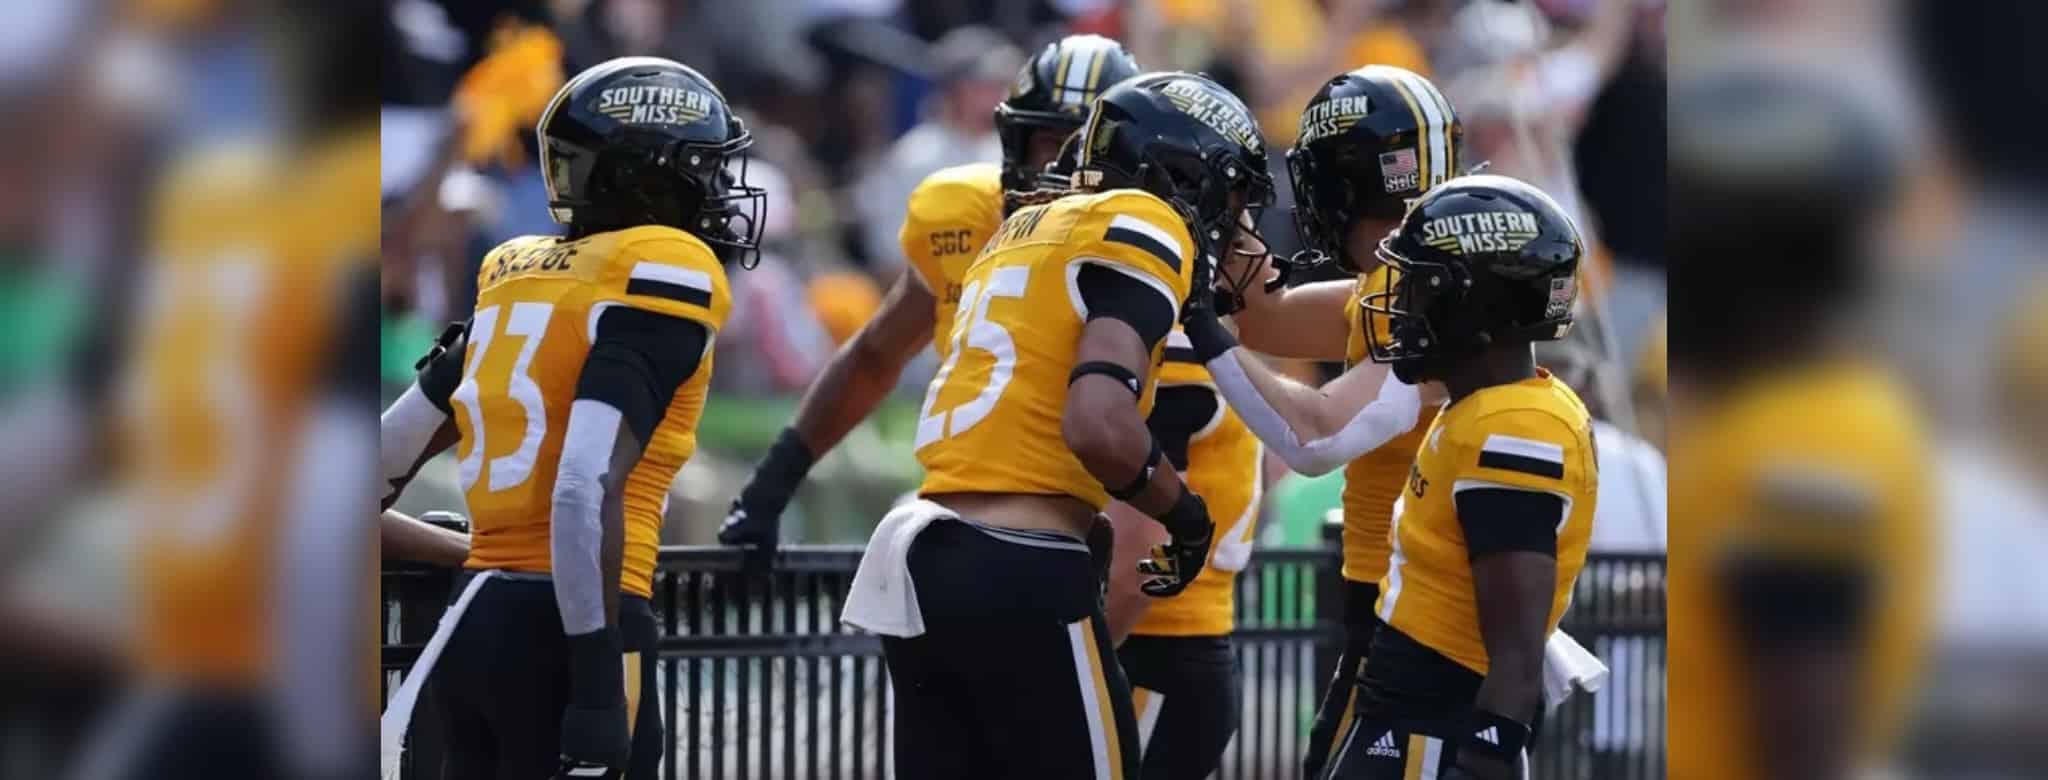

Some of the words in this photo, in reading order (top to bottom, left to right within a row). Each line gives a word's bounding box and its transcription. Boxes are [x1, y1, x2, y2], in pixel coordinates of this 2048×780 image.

[600, 86, 711, 118] SOUTHERN
[632, 104, 678, 123] MISS
[1161, 81, 1260, 151] SOUTHERN
[1302, 96, 1368, 124] UTHERN
[1187, 103, 1230, 135] MISS
[1423, 211, 1539, 241] SOUTHERN
[1459, 232, 1508, 253] MISS
[913, 265, 1031, 451] 25
[449, 301, 555, 492] 33
[1366, 747, 1401, 758] adidas
